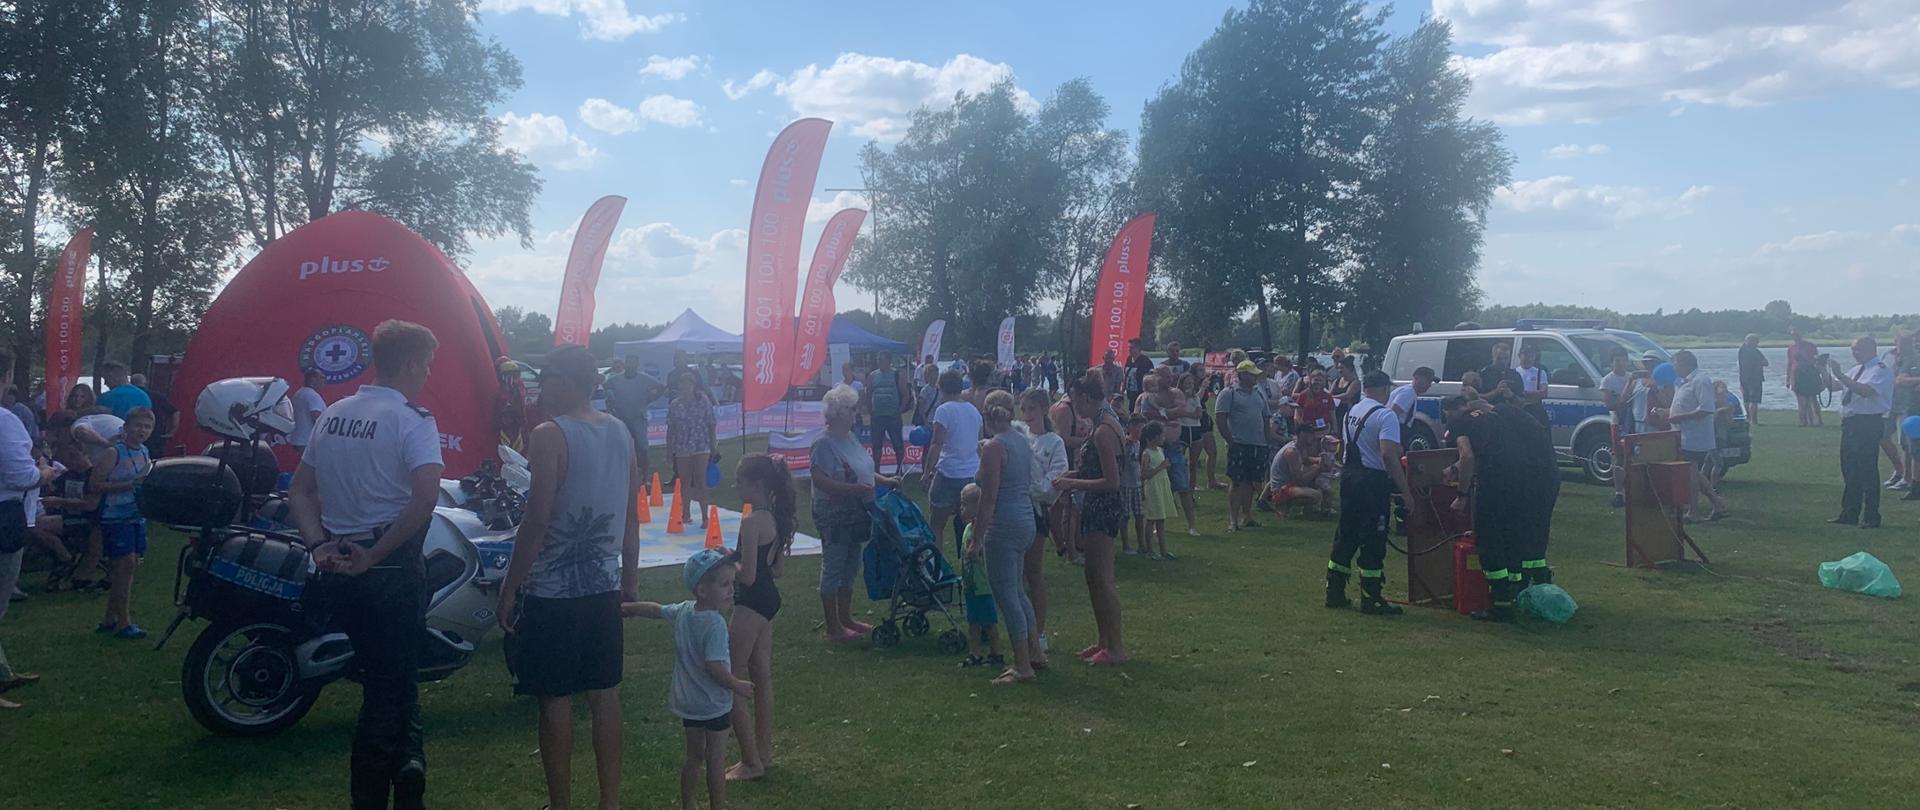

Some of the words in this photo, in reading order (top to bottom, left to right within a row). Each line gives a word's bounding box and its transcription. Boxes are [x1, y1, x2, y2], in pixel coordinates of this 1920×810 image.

[774, 158, 794, 204] plus
[760, 211, 779, 246] 100
[299, 255, 364, 280] plus
[758, 254, 776, 286] 100
[1117, 245, 1130, 273] plus
[813, 263, 828, 285] 100
[809, 288, 823, 309] 100
[1113, 281, 1124, 304] 100
[756, 297, 774, 329] 601
[1110, 306, 1122, 330] 100
[60, 322, 69, 343] 100
[562, 319, 577, 343] 601
[804, 315, 817, 336] 601
[235, 567, 284, 595] POLICJA
